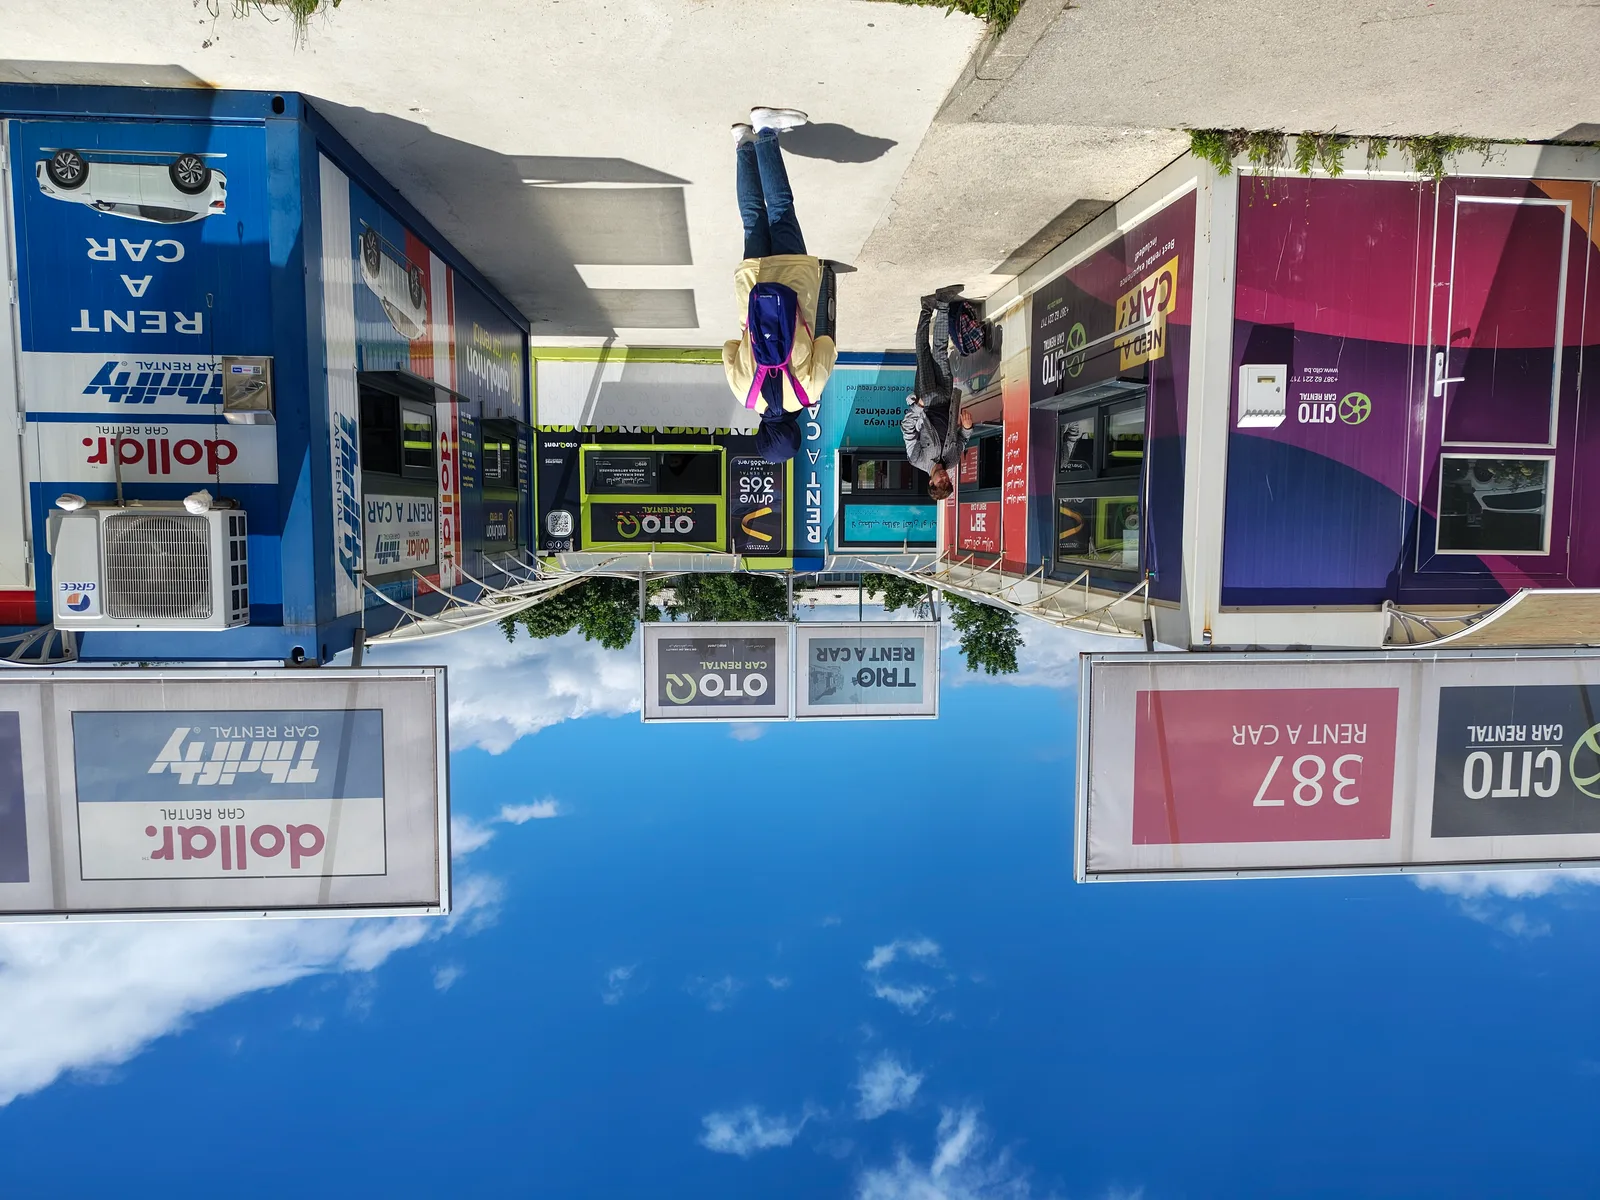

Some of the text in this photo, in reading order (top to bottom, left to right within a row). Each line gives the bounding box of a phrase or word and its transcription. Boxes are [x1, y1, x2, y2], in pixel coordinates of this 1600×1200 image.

[85, 238, 185, 263] CAR
[1134, 236, 1158, 261] included!
[1119, 238, 1175, 287] Best rental experience
[119, 275, 153, 297] A
[1119, 270, 1172, 330] CAR?
[71, 310, 202, 334] RENT
[1123, 327, 1162, 360] NEED A
[135, 361, 191, 371] RENTAL
[197, 361, 223, 371] CAR
[466, 345, 509, 396] autoUnion
[82, 361, 224, 405] Thrifty
[846, 384, 872, 392] required
[1299, 393, 1337, 401] CAR RENTAL
[855, 407, 901, 417] gerekmez
[864, 418, 885, 426] veya
[1298, 403, 1336, 423] CITO
[96, 425, 168, 436] CAR RENTAL
[82, 438, 238, 475] dollar.
[333, 411, 343, 525] CAR RENTAL
[806, 394, 821, 543] RENT A CA
[739, 477, 774, 493] 365
[740, 494, 773, 505] drive
[367, 501, 433, 523] RENT A CAR
[970, 513, 986, 532] 387
[60, 582, 96, 592] GREE
[816, 647, 915, 662] RENT A CAR
[700, 661, 767, 670] CAR RENTAL
[857, 668, 916, 687] TRIO
[210, 725, 320, 738] CAR RENTAL
[1232, 724, 1367, 745] RENT A CAR
[1467, 724, 1563, 742] CAR RENTAL
[148, 727, 320, 785] Thrifty
[1253, 754, 1362, 807] 387
[160, 808, 245, 821] CAR RENTAL
[145, 824, 325, 870] dollar.
